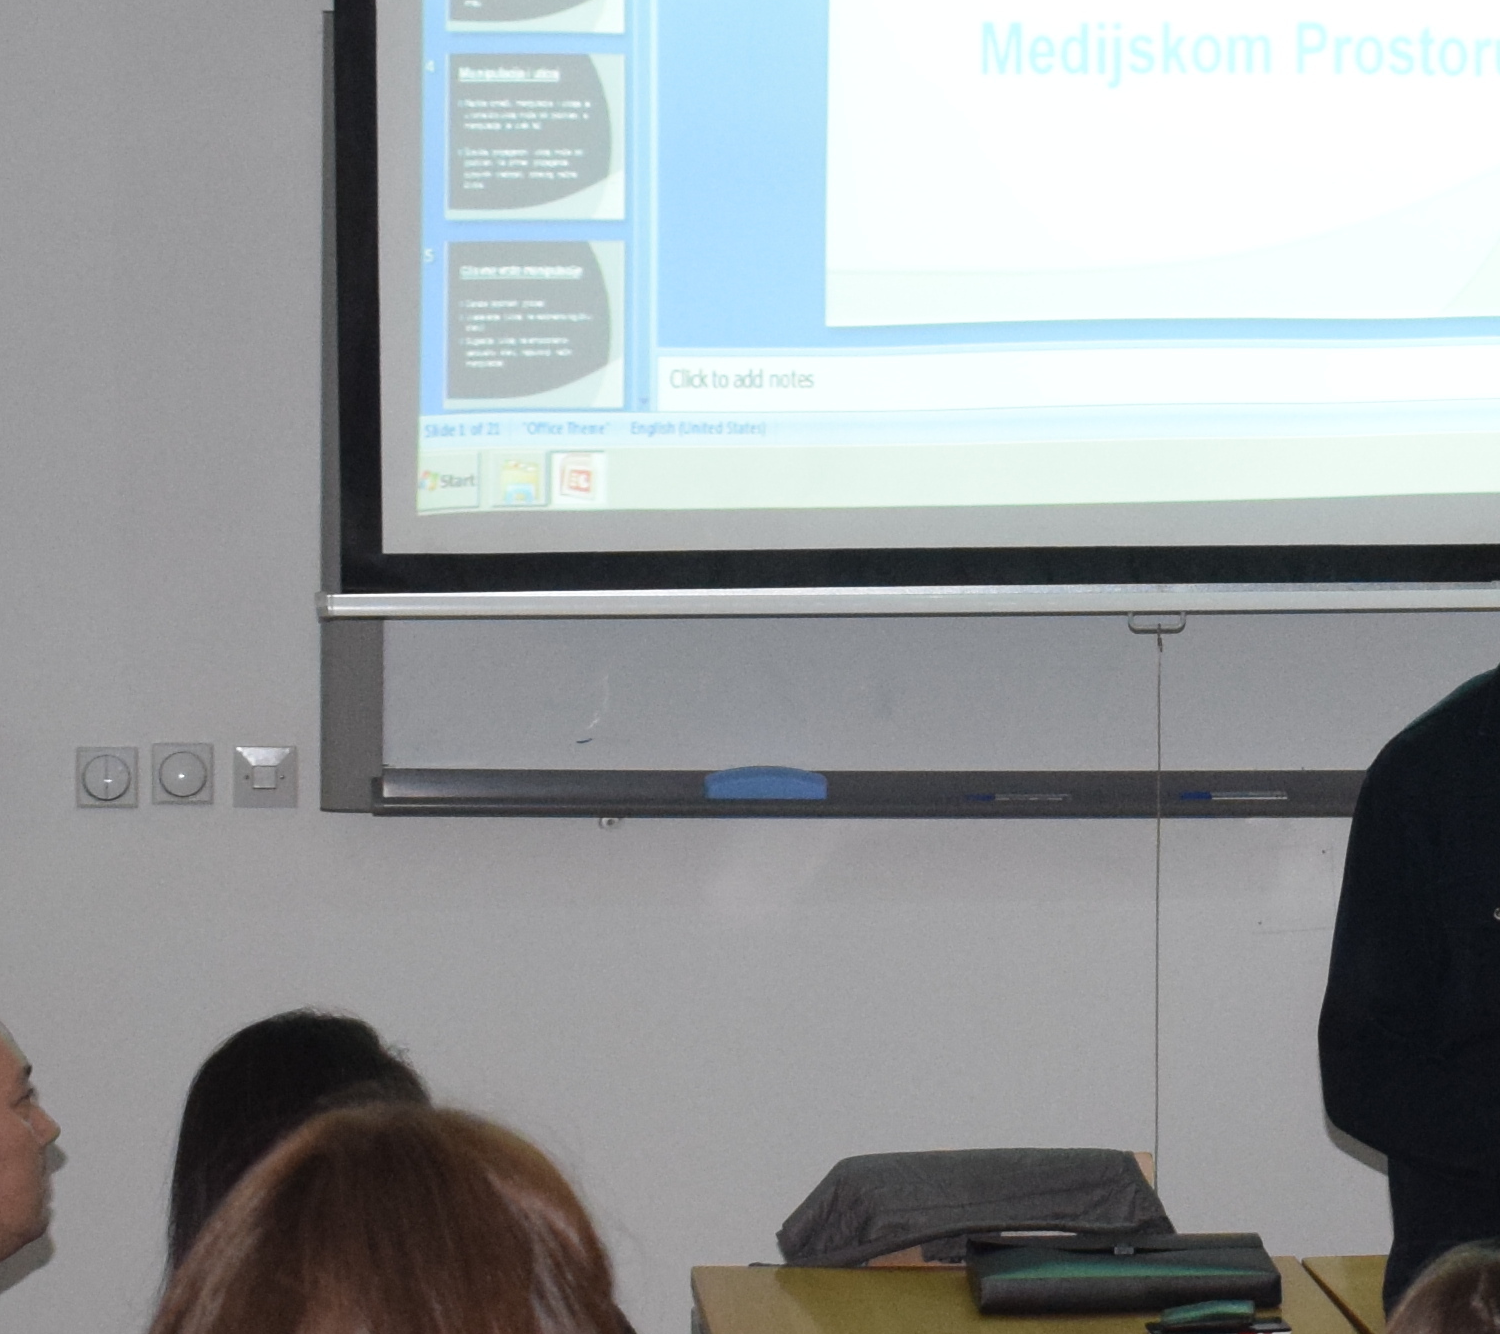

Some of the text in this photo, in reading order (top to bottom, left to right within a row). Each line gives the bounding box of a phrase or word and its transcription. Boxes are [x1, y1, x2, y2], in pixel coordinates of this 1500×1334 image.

[980, 20, 1272, 89] Medijskom
[669, 368, 815, 388] Click to add notes
[424, 422, 455, 438] Slide
[469, 421, 483, 437] of
[630, 421, 767, 438] English (United States)
[439, 473, 475, 488] Start
